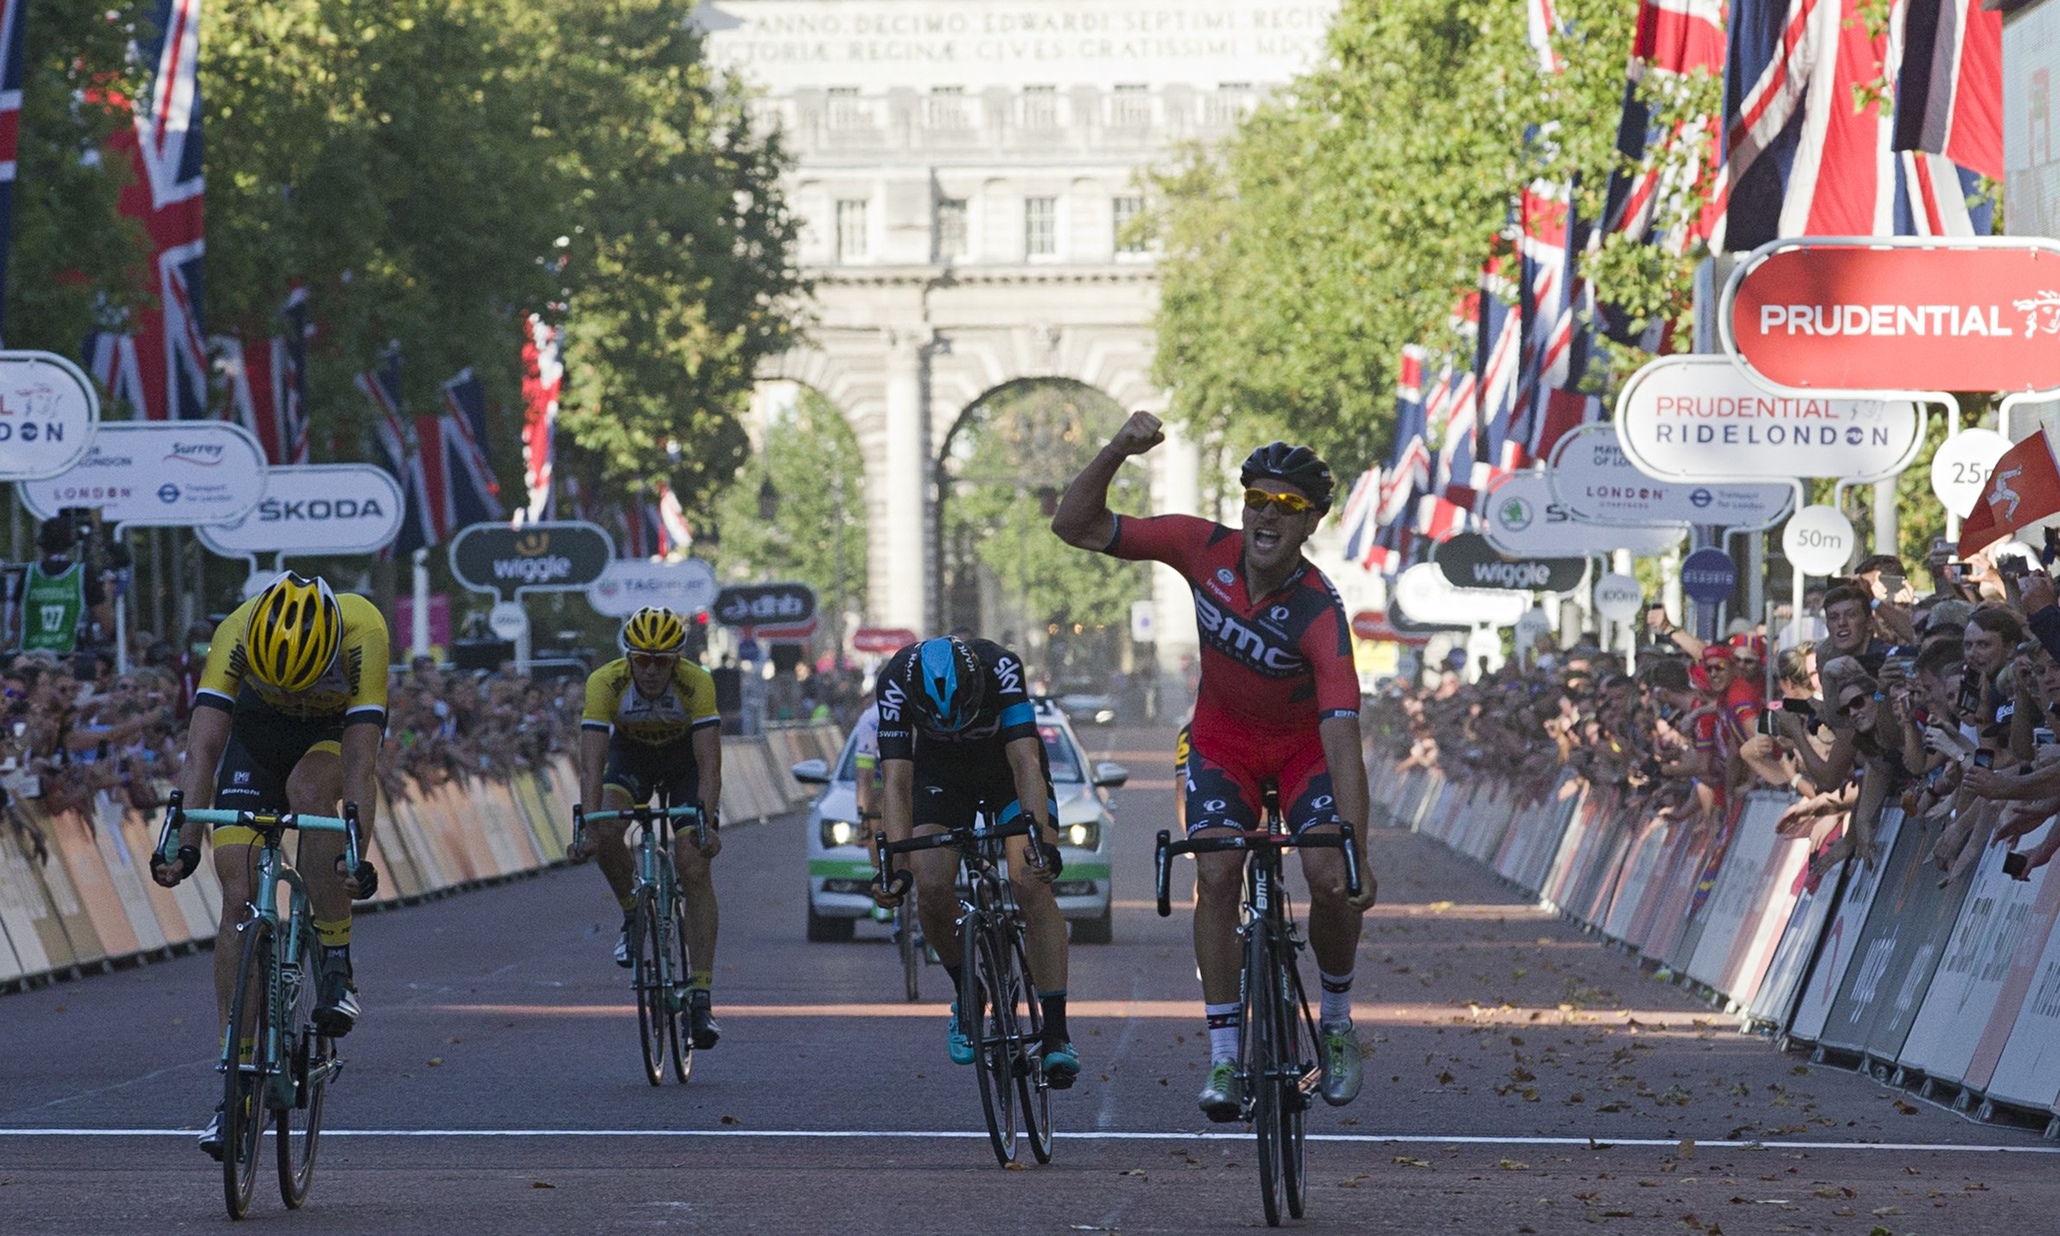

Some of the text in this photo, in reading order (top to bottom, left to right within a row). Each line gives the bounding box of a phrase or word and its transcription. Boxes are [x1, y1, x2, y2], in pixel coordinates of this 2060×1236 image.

[1760, 304, 2012, 336] PRUDENTIAL
[1656, 397, 1839, 418] PRUDENTIAL
[1656, 425, 1888, 445] RIDELONDON
[1586, 486, 1663, 500] LONDON
[1798, 529, 1841, 548] 50m
[493, 555, 572, 582] wiggle
[1472, 561, 1551, 588] wiggle
[879, 729, 910, 738] SWIFTY
[1255, 868, 1268, 911] BMC
